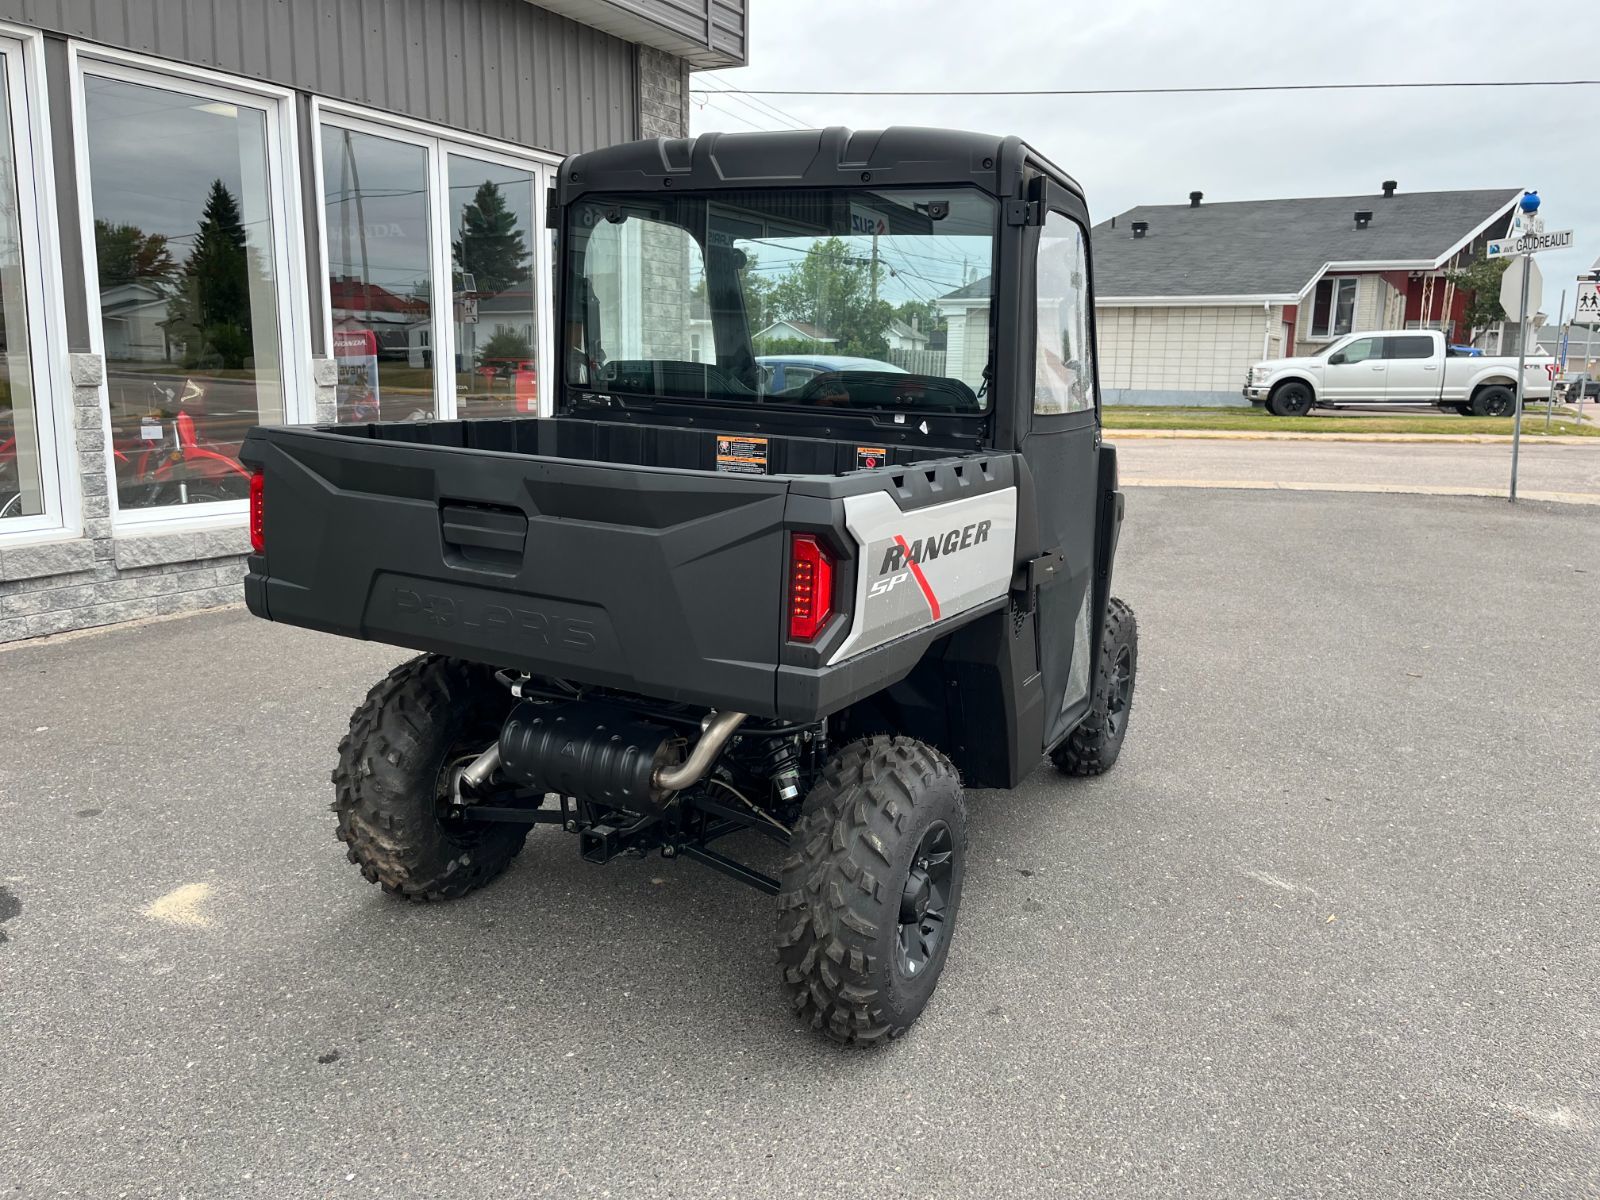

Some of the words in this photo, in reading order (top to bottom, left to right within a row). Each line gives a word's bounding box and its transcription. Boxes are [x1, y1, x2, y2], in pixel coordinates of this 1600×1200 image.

[1503, 245, 1514, 253] AVE
[1516, 232, 1571, 252] GAUDREAULT
[334, 339, 367, 348] HONDA
[879, 519, 992, 576] RANGER
[867, 572, 909, 599] SP
[392, 587, 600, 650] POLARIS
